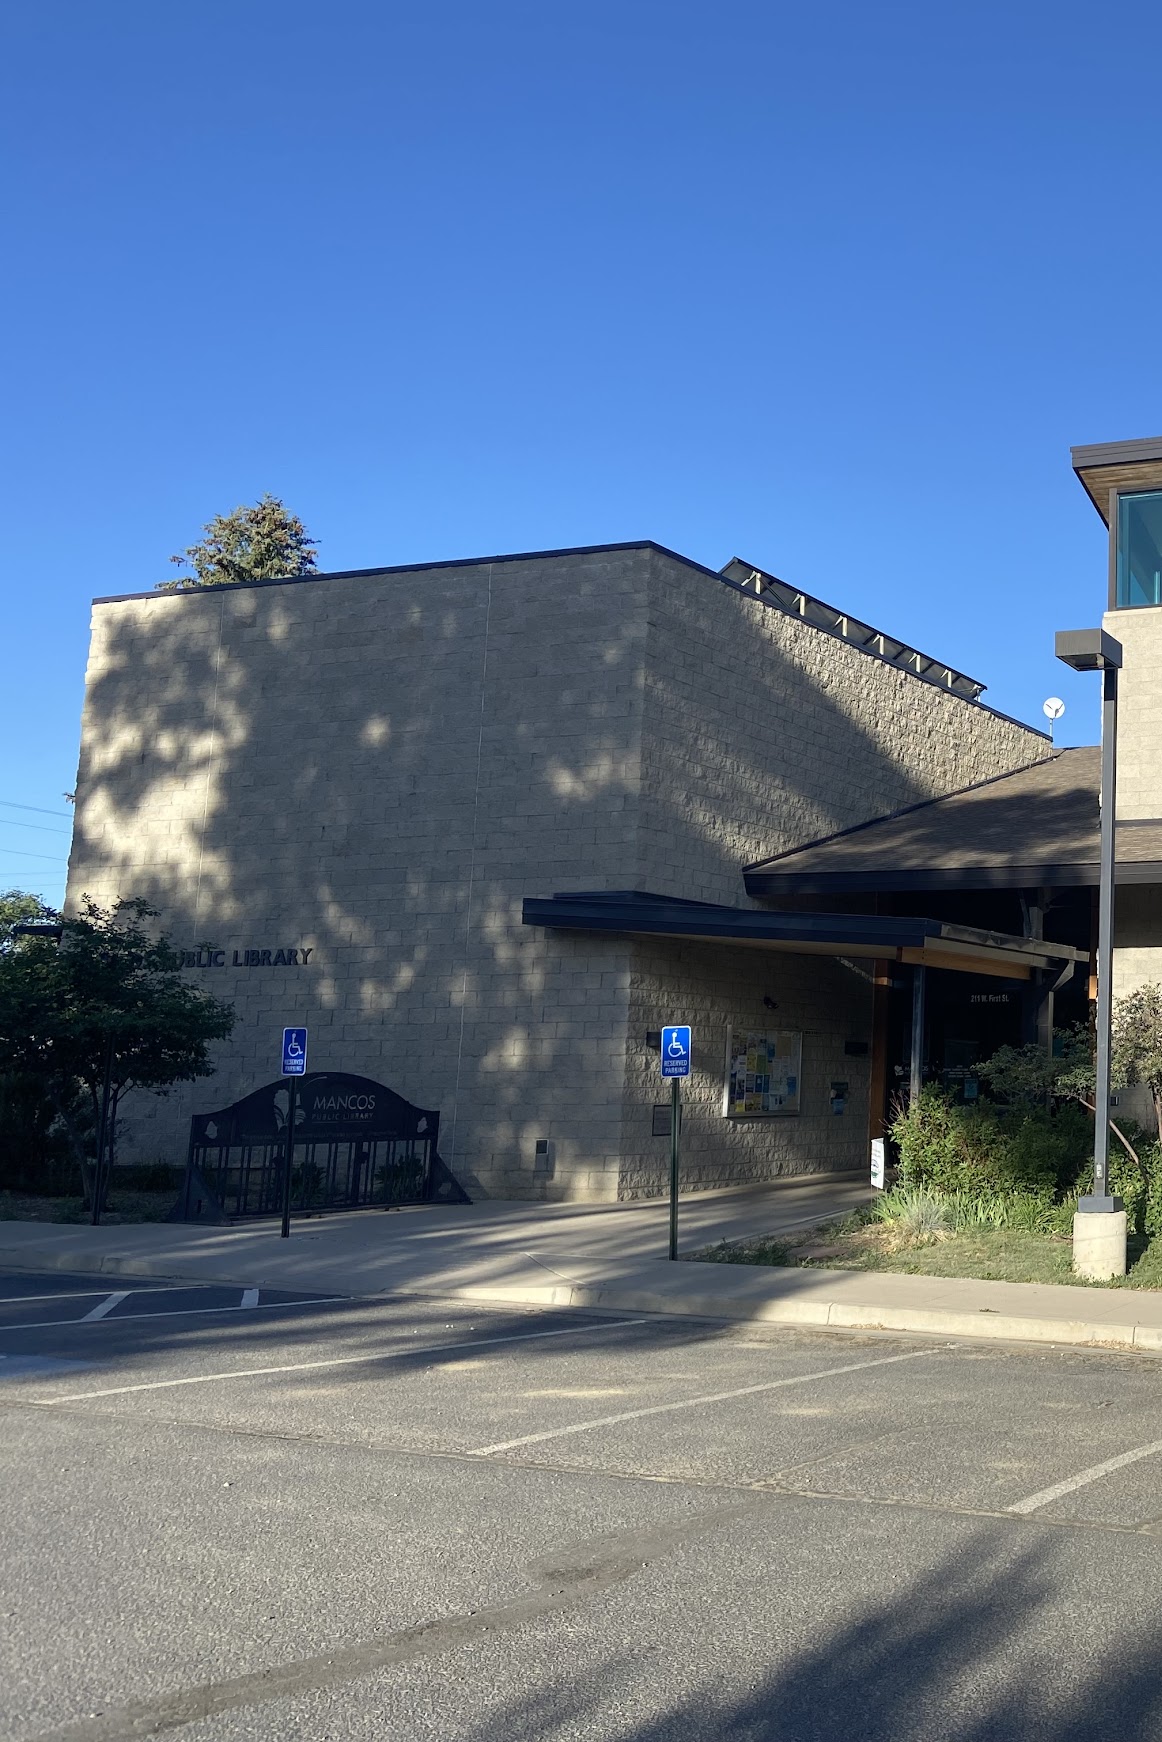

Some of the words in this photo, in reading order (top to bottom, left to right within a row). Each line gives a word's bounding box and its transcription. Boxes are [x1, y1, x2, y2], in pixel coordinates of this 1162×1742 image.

[167, 950, 226, 968] UBLIC
[232, 948, 313, 967] LIBRARY
[988, 994, 1001, 1003] First
[663, 1059, 688, 1067] RESERVED
[664, 1066, 687, 1074] PARKING
[313, 1094, 376, 1110] MANCOS
[312, 1112, 340, 1121] PUBLIC
[342, 1112, 374, 1120] LIBRARY
